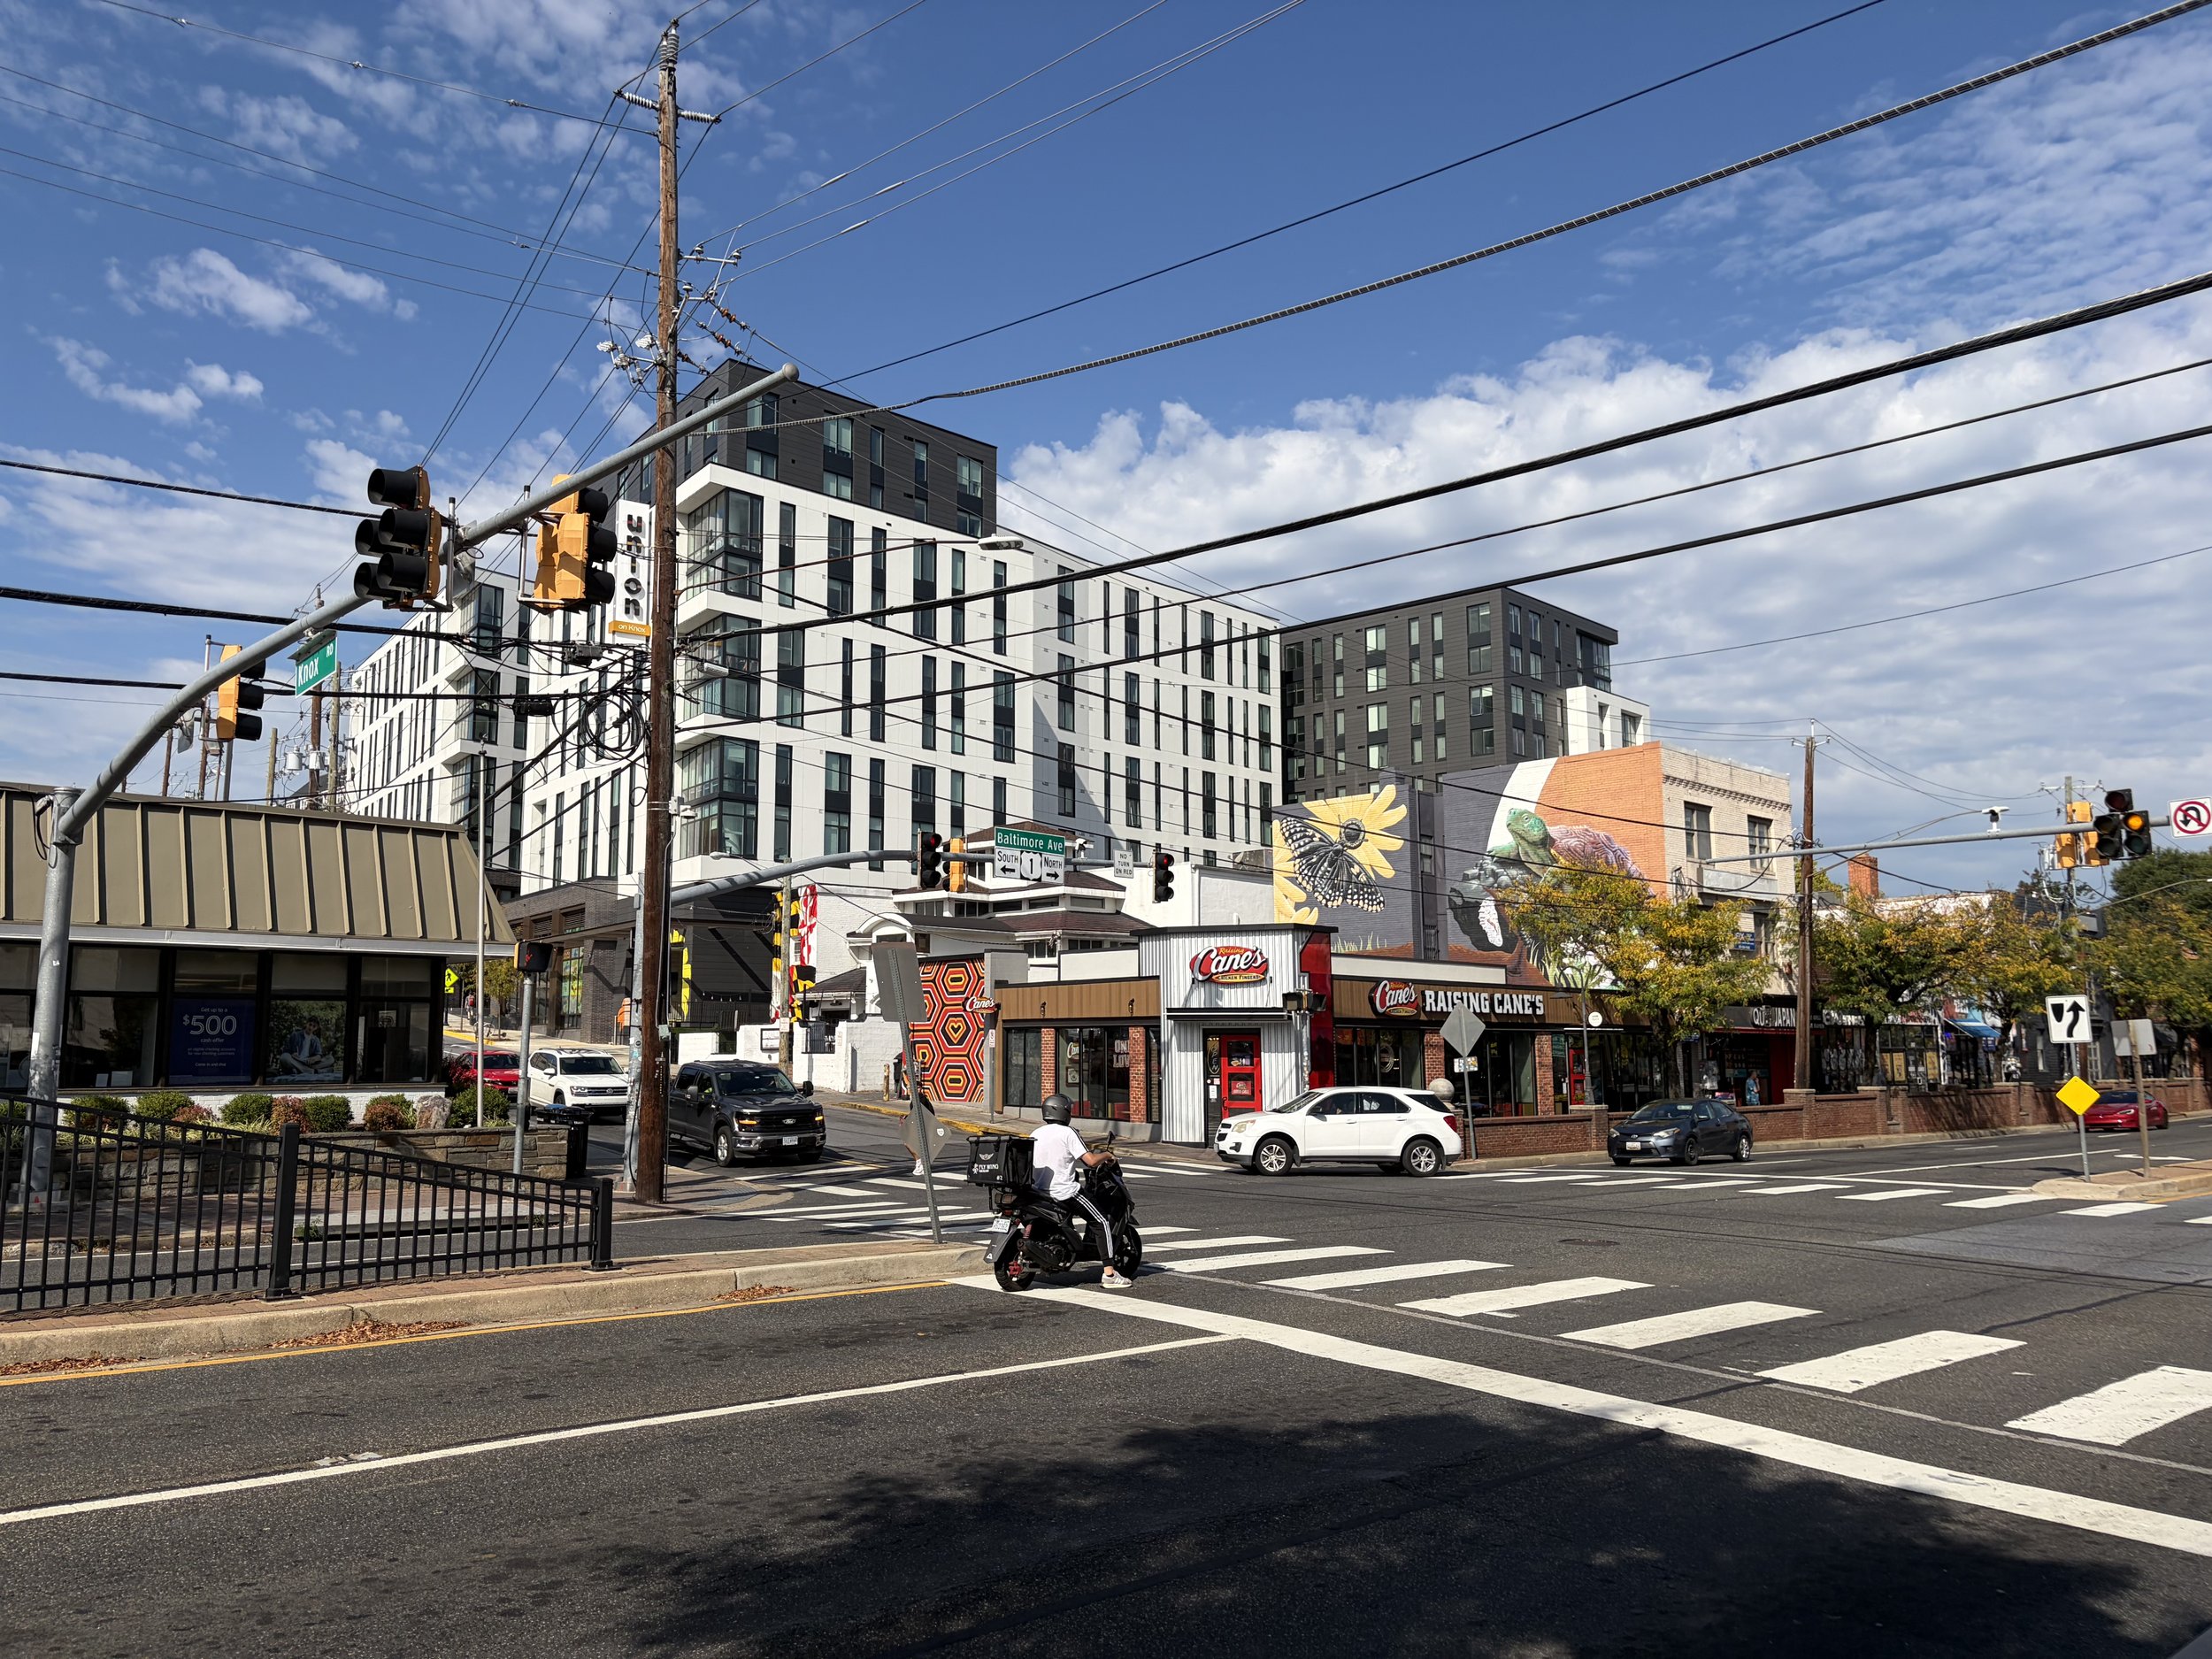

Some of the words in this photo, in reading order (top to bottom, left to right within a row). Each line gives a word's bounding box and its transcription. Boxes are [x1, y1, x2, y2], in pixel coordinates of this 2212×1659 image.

[628, 624, 646, 634] Knox
[297, 657, 319, 687] Knox
[326, 642, 334, 658] RD
[997, 832, 1044, 849] Baltimore
[1047, 839, 1064, 852] Ave
[997, 850, 1018, 864] SOUTH
[1029, 857, 1033, 875] 1
[1044, 856, 1063, 869] NORTH
[1193, 945, 1267, 981] Cane's
[965, 996, 995, 1012] Cane's
[1375, 979, 1417, 1013] Cane's
[1425, 989, 1490, 1013] RAISING
[1494, 993, 1544, 1015] CANE'S
[182, 1014, 237, 1035] $500
[1775, 1007, 1796, 1027] JAPAN
[1114, 1039, 1130, 1054] ON
[1210, 1046, 1219, 1071] OPEN
